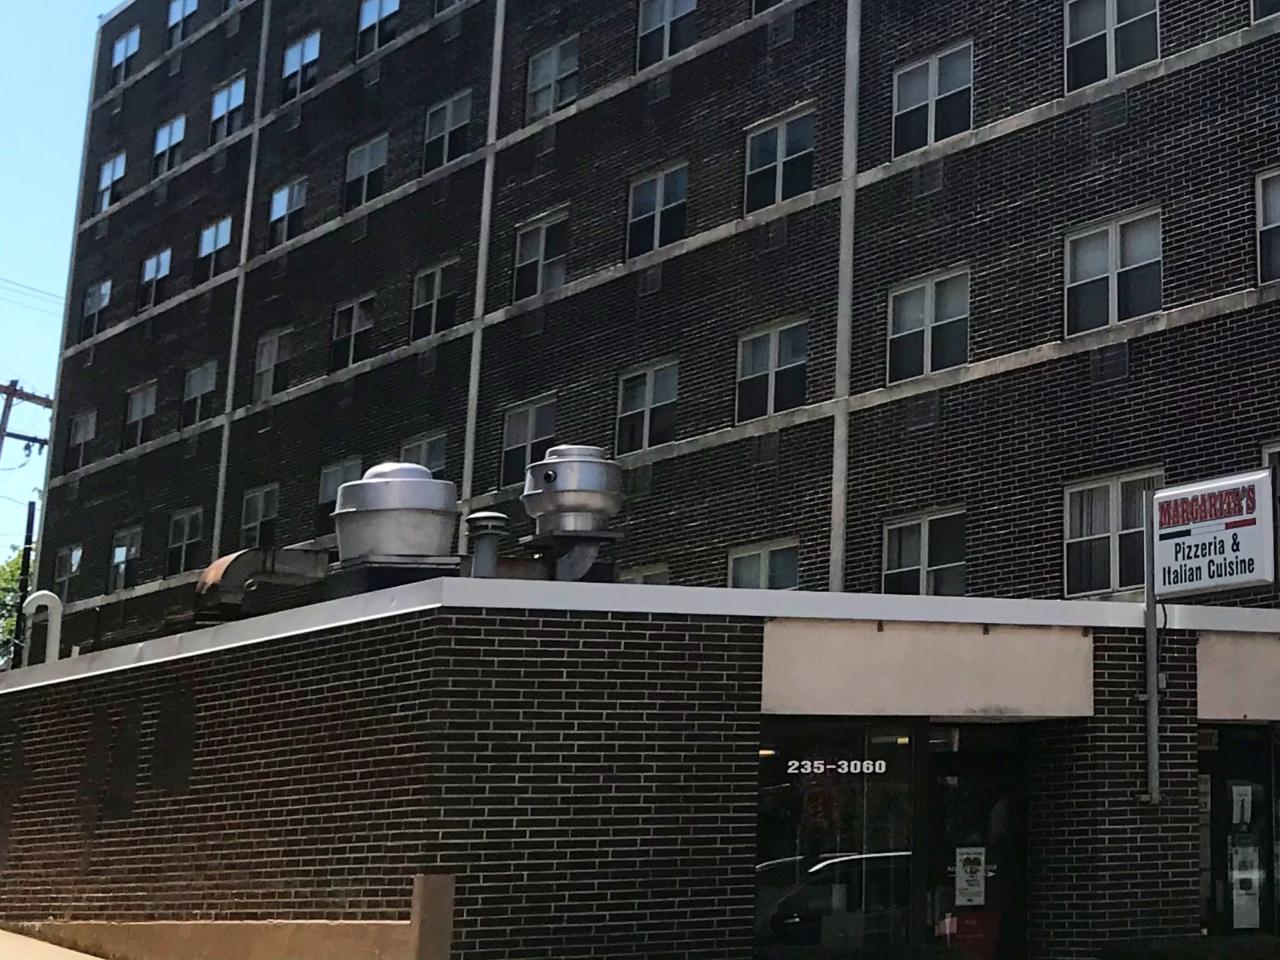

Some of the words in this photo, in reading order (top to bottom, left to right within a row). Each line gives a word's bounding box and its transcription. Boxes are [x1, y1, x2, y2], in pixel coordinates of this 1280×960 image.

[1158, 485, 1257, 530] MARGARITA'S
[1174, 536, 1225, 562] Pizzeria
[1231, 532, 1240, 553] &
[1163, 564, 1202, 586] Italian
[1207, 556, 1255, 580] Cuisine
[787, 760, 886, 774] 235-3060
